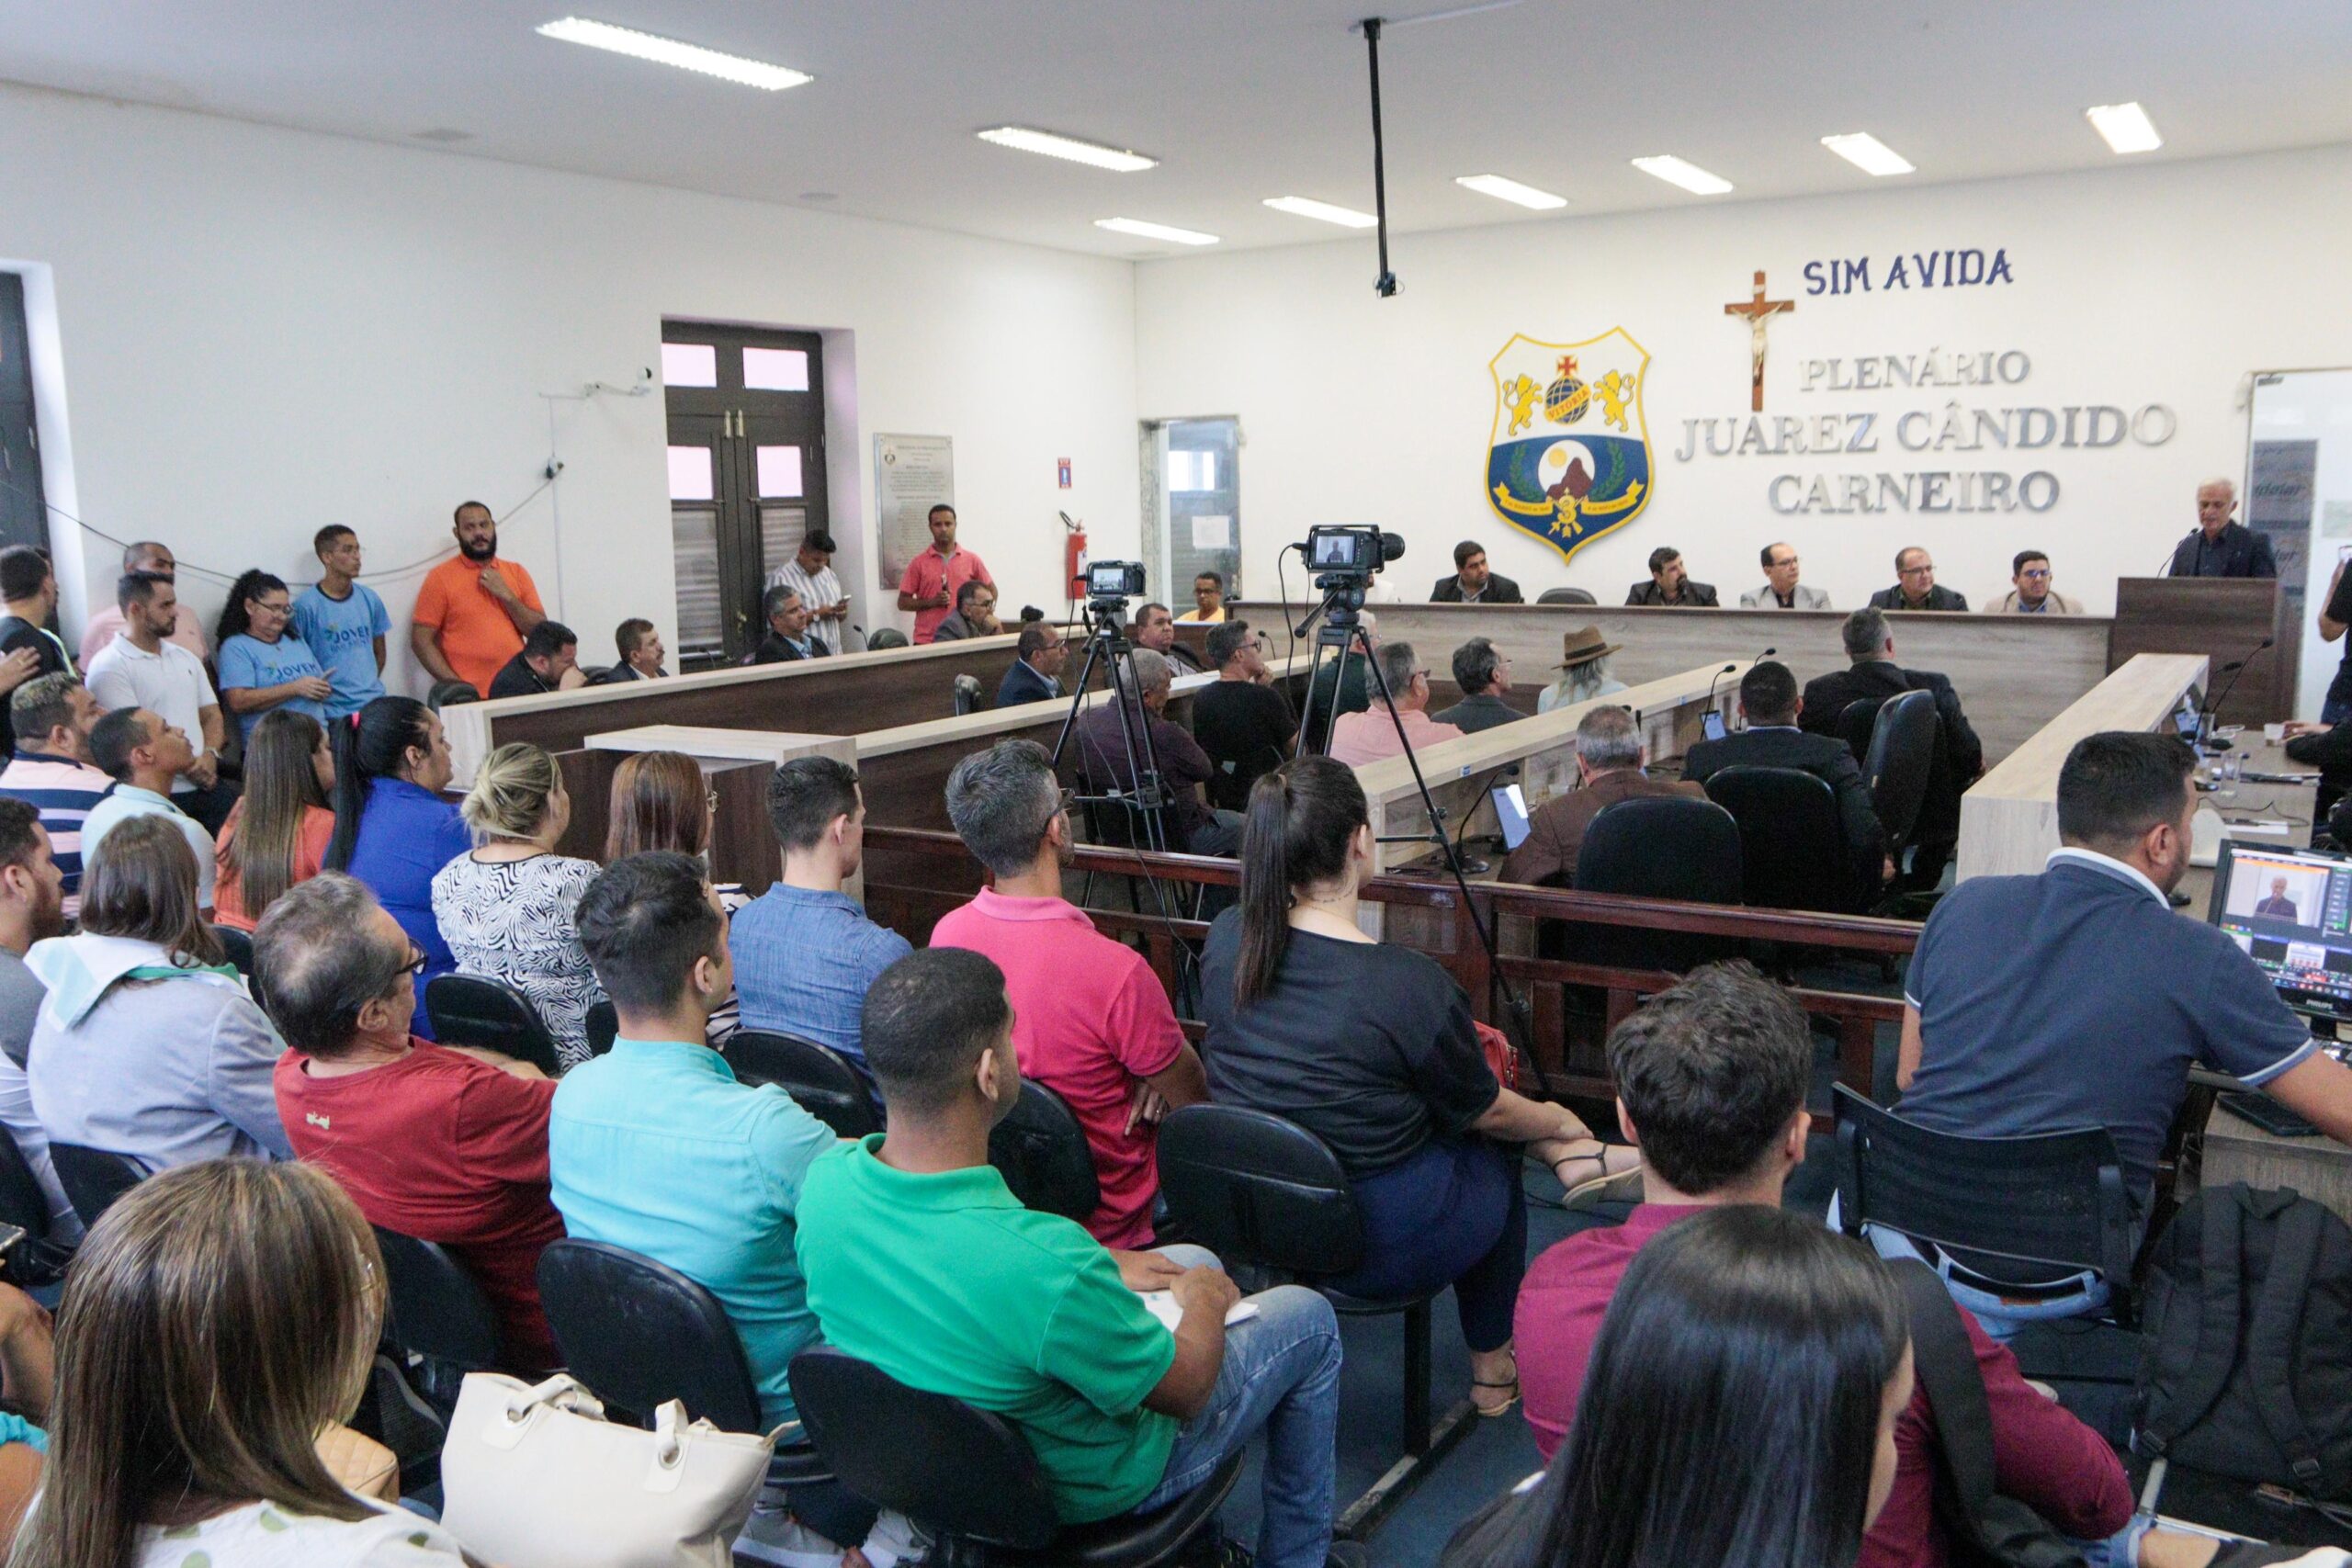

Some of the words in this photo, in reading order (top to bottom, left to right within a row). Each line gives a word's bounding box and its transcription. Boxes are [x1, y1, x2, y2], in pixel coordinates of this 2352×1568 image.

[1803, 256, 1871, 296] SIM
[1800, 345, 2031, 392] PLENÁRIO
[1674, 412, 1879, 462] JUAREZ
[1896, 399, 2177, 452] CÂNDIDO
[1768, 470, 2061, 514] CARNEIRO
